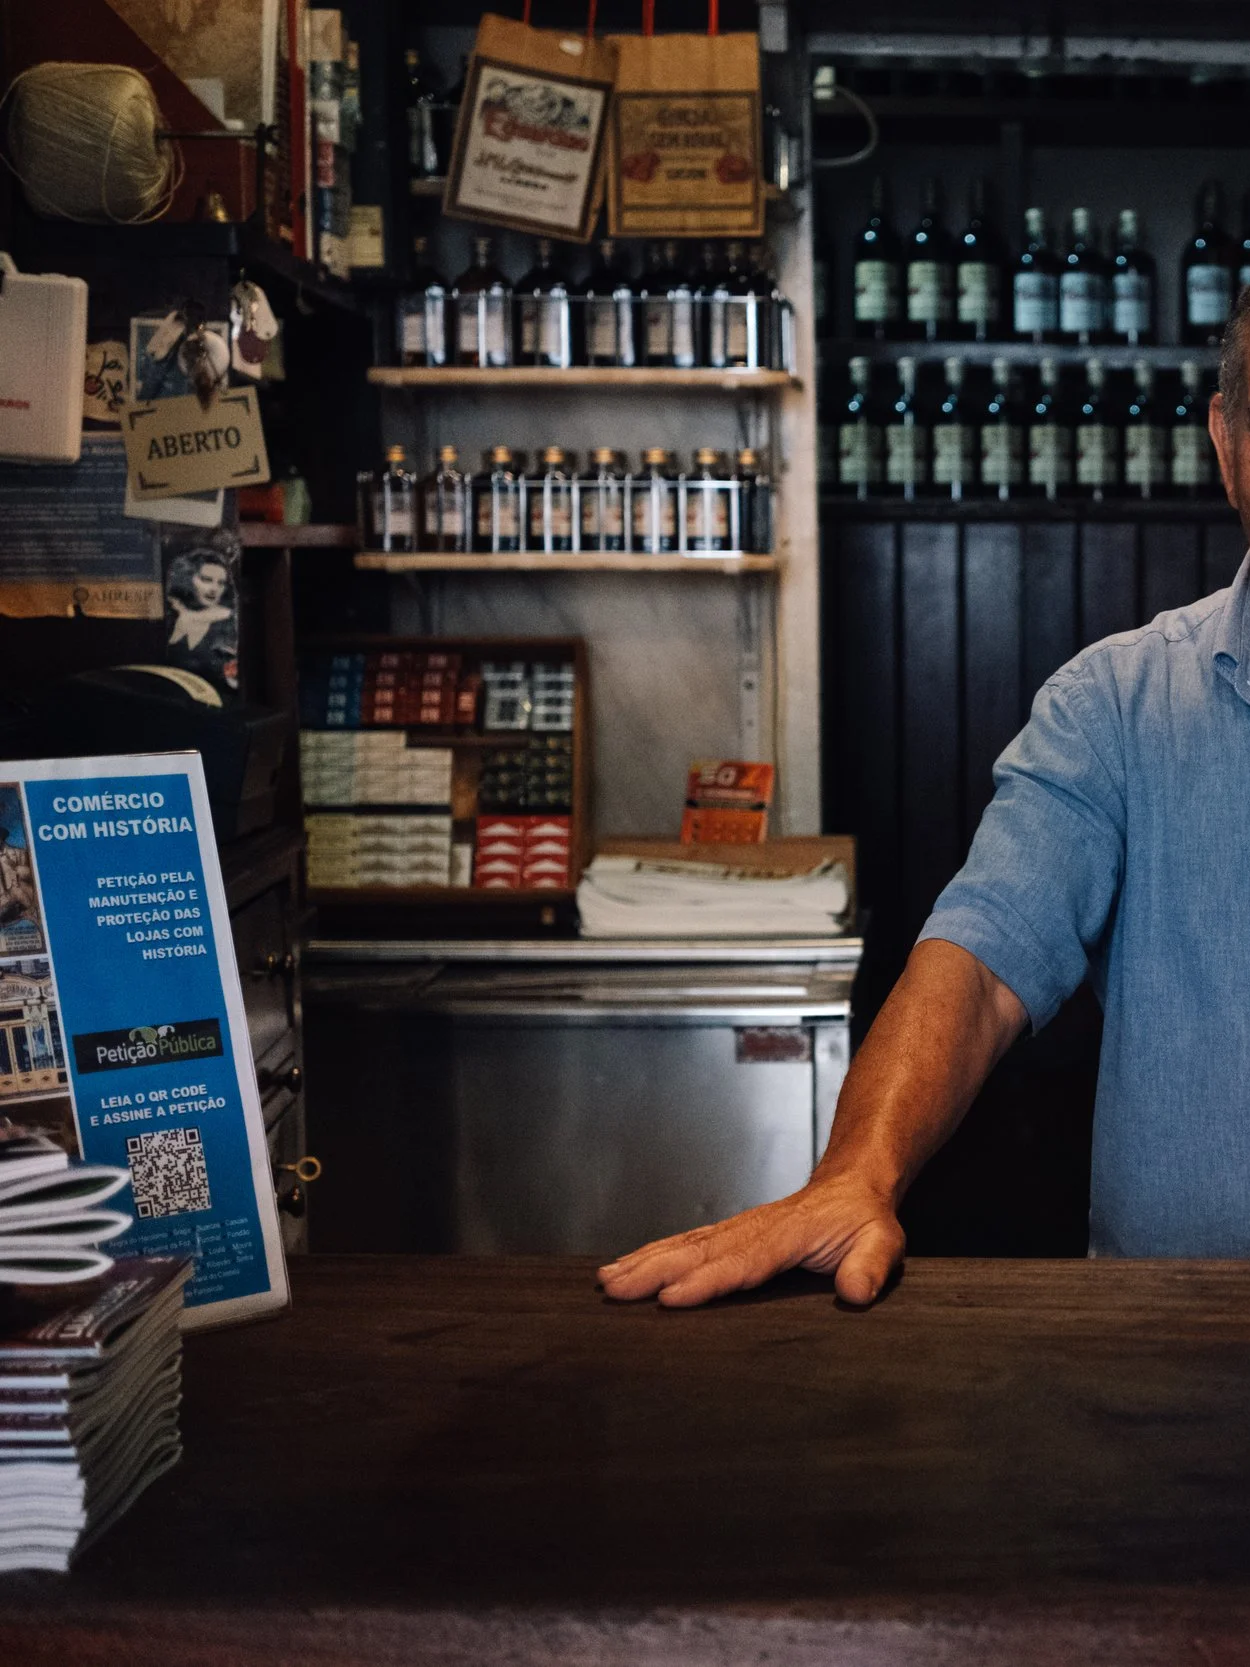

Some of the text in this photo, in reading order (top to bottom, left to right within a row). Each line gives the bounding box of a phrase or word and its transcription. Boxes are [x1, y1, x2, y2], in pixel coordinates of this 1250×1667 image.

[147, 426, 241, 460] ABERTO
[53, 791, 164, 814] COMÉRCIO
[38, 815, 193, 842] COM HISTÓRIA
[97, 871, 195, 889] PETIÇÃO PELA
[89, 889, 198, 909] MANUTENÇÃO E
[97, 907, 201, 927] PROTEÇÃO DAS
[126, 926, 203, 943] LOJAS COM
[142, 943, 207, 960] HISTÓRIA
[96, 1034, 216, 1065] Petição Pública
[101, 1084, 208, 1109] LEIA O QR CODE
[90, 1097, 226, 1127] E ASSINE A PETIÇÃO
